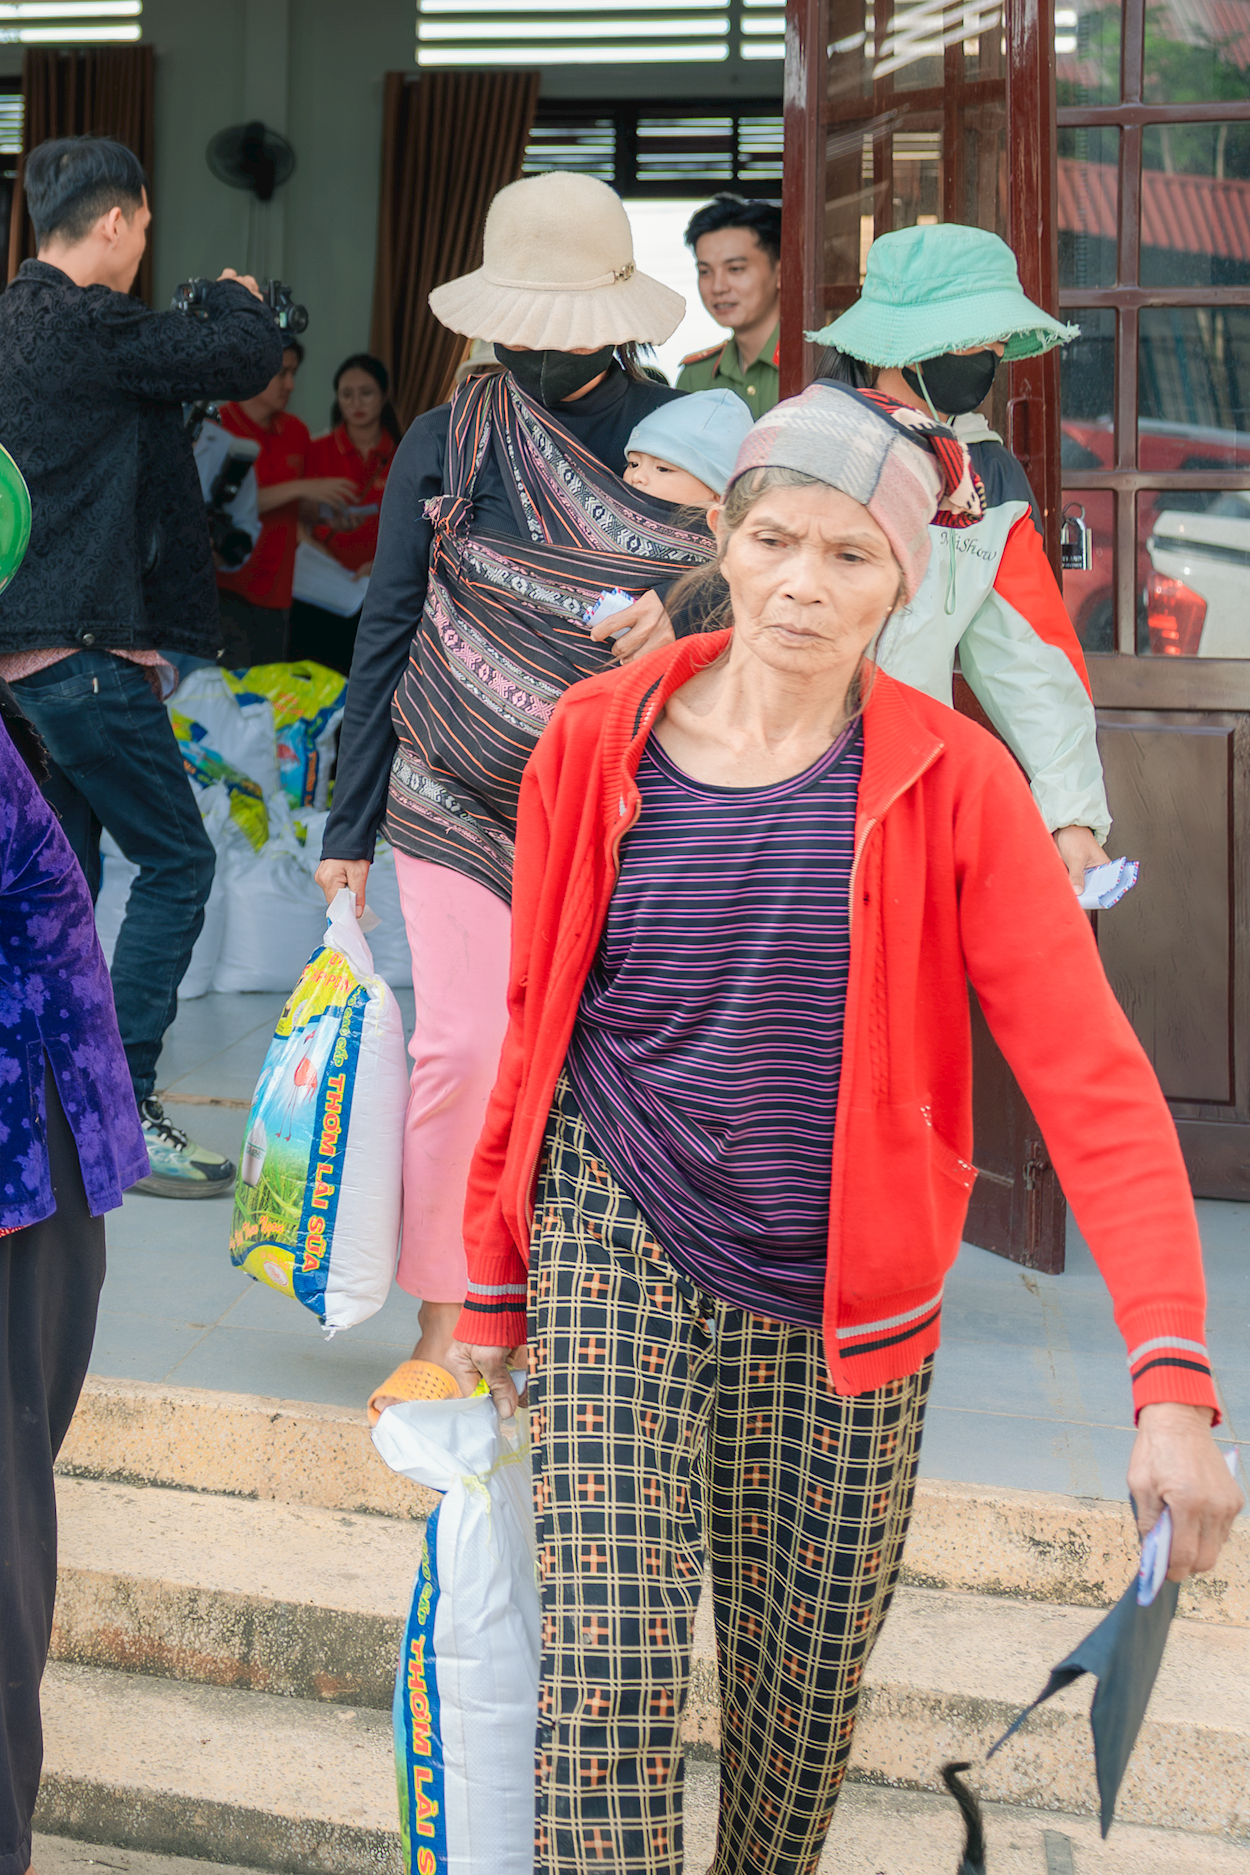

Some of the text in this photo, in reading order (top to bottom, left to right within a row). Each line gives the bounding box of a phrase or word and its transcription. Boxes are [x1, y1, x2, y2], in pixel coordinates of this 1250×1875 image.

[301, 1006, 353, 1273] CAO CẤP THƠM LÀI SỮA
[407, 1634, 433, 1757] THƠM
[414, 1764, 439, 1839] LÀI
